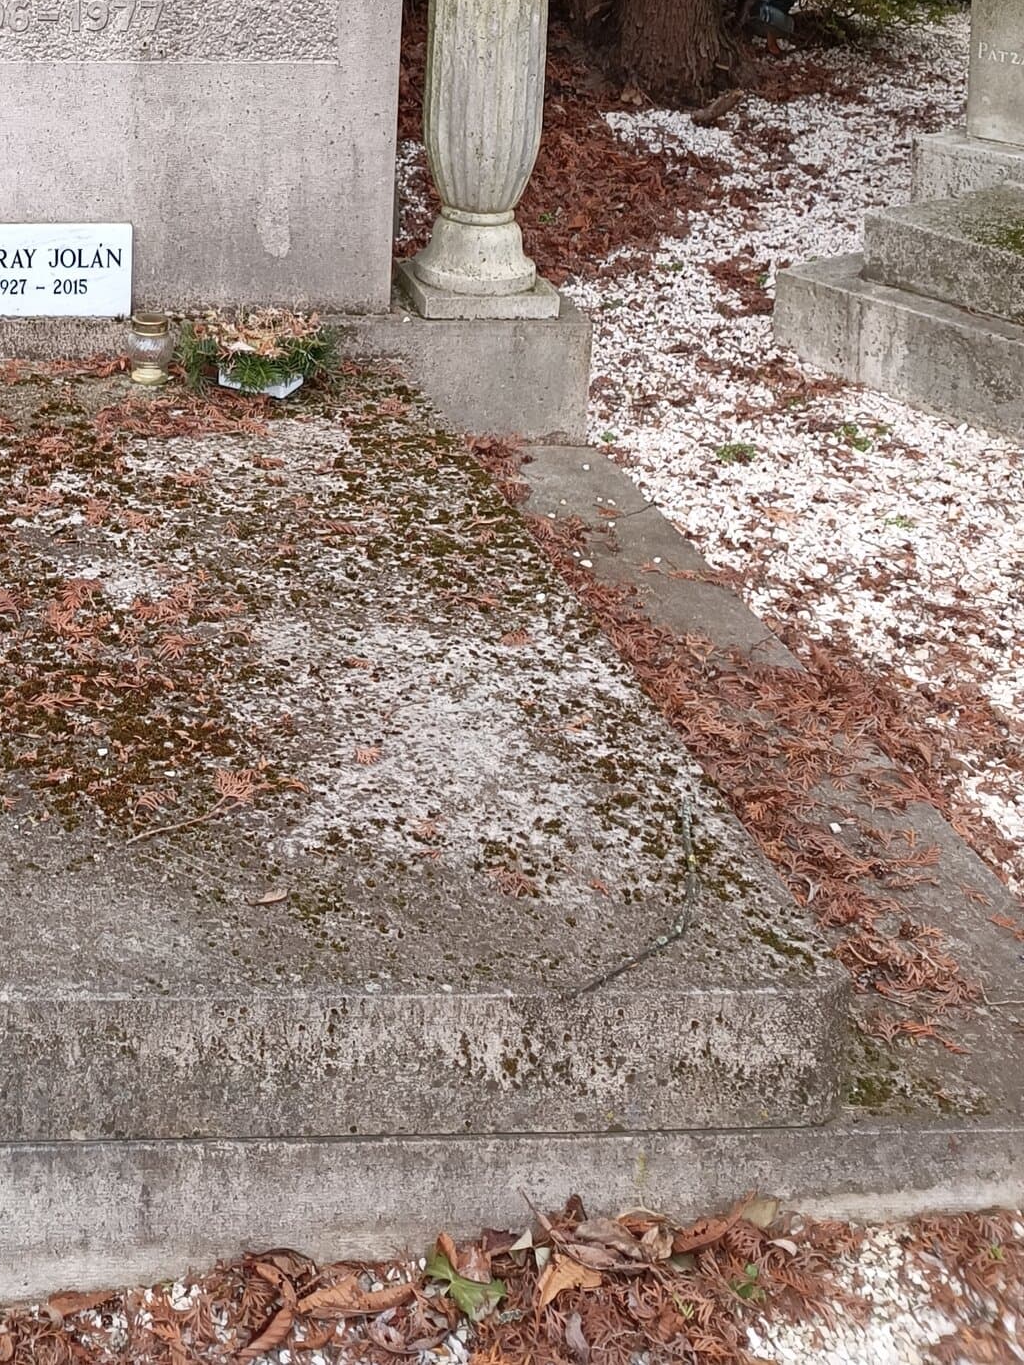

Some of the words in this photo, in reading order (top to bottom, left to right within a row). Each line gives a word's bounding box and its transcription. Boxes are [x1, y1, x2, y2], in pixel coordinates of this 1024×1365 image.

[978, 40, 1024, 65] PÁTZ
[48, 243, 123, 269] JOLÁN
[53, 279, 88, 295] 2015
